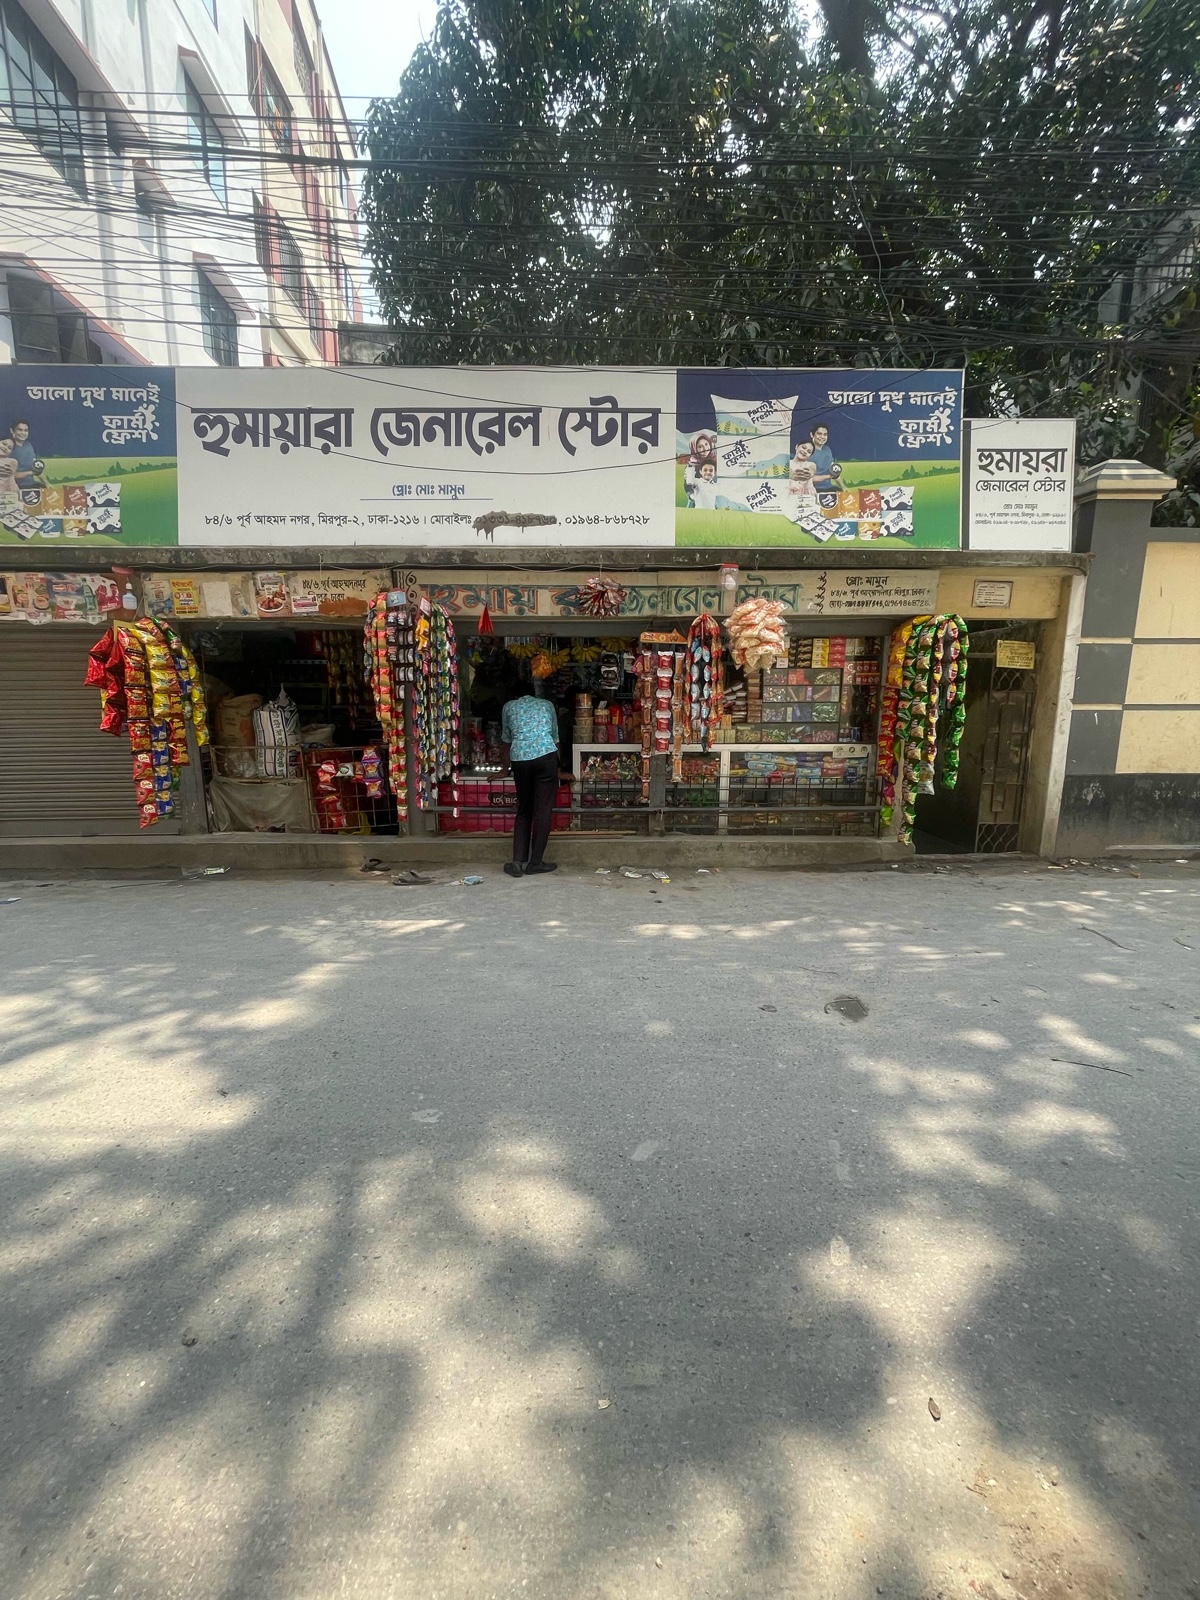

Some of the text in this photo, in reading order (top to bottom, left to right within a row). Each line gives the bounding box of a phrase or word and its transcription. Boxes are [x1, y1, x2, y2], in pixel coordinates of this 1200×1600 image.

[27, 382, 161, 408] ভালো দুধ মানেই
[828, 386, 958, 412] ভালো দুধ মানেই
[747, 402, 769, 418] Farm
[751, 409, 774, 425] Fresh
[191, 395, 662, 457] হুমায়ারা জেনারেল স্টোর
[102, 429, 148, 445] ফ্রেশ
[898, 432, 942, 449] ফ্রেশ
[977, 448, 1068, 476] হুমায়রা
[392, 484, 465, 499] প্রোঃ মোঃ মামুন
[975, 476, 1066, 493] জেনারেল স্টোর
[745, 487, 768, 503] Farm
[750, 494, 773, 510] Fresh
[204, 514, 234, 527] ৮৪/৬
[237, 512, 253, 529] পূর্ব
[256, 514, 287, 527] আহমদ
[290, 515, 314, 528] নগর,
[318, 512, 364, 528] মিরপুর-২,
[368, 514, 420, 526] ঢাকা-১২১৬
[430, 512, 472, 526] মোবাইলঃ
[565, 514, 650, 526] ০১৯৬৪-৮৬৮৭২৮
[865, 575, 889, 588] মামুন
